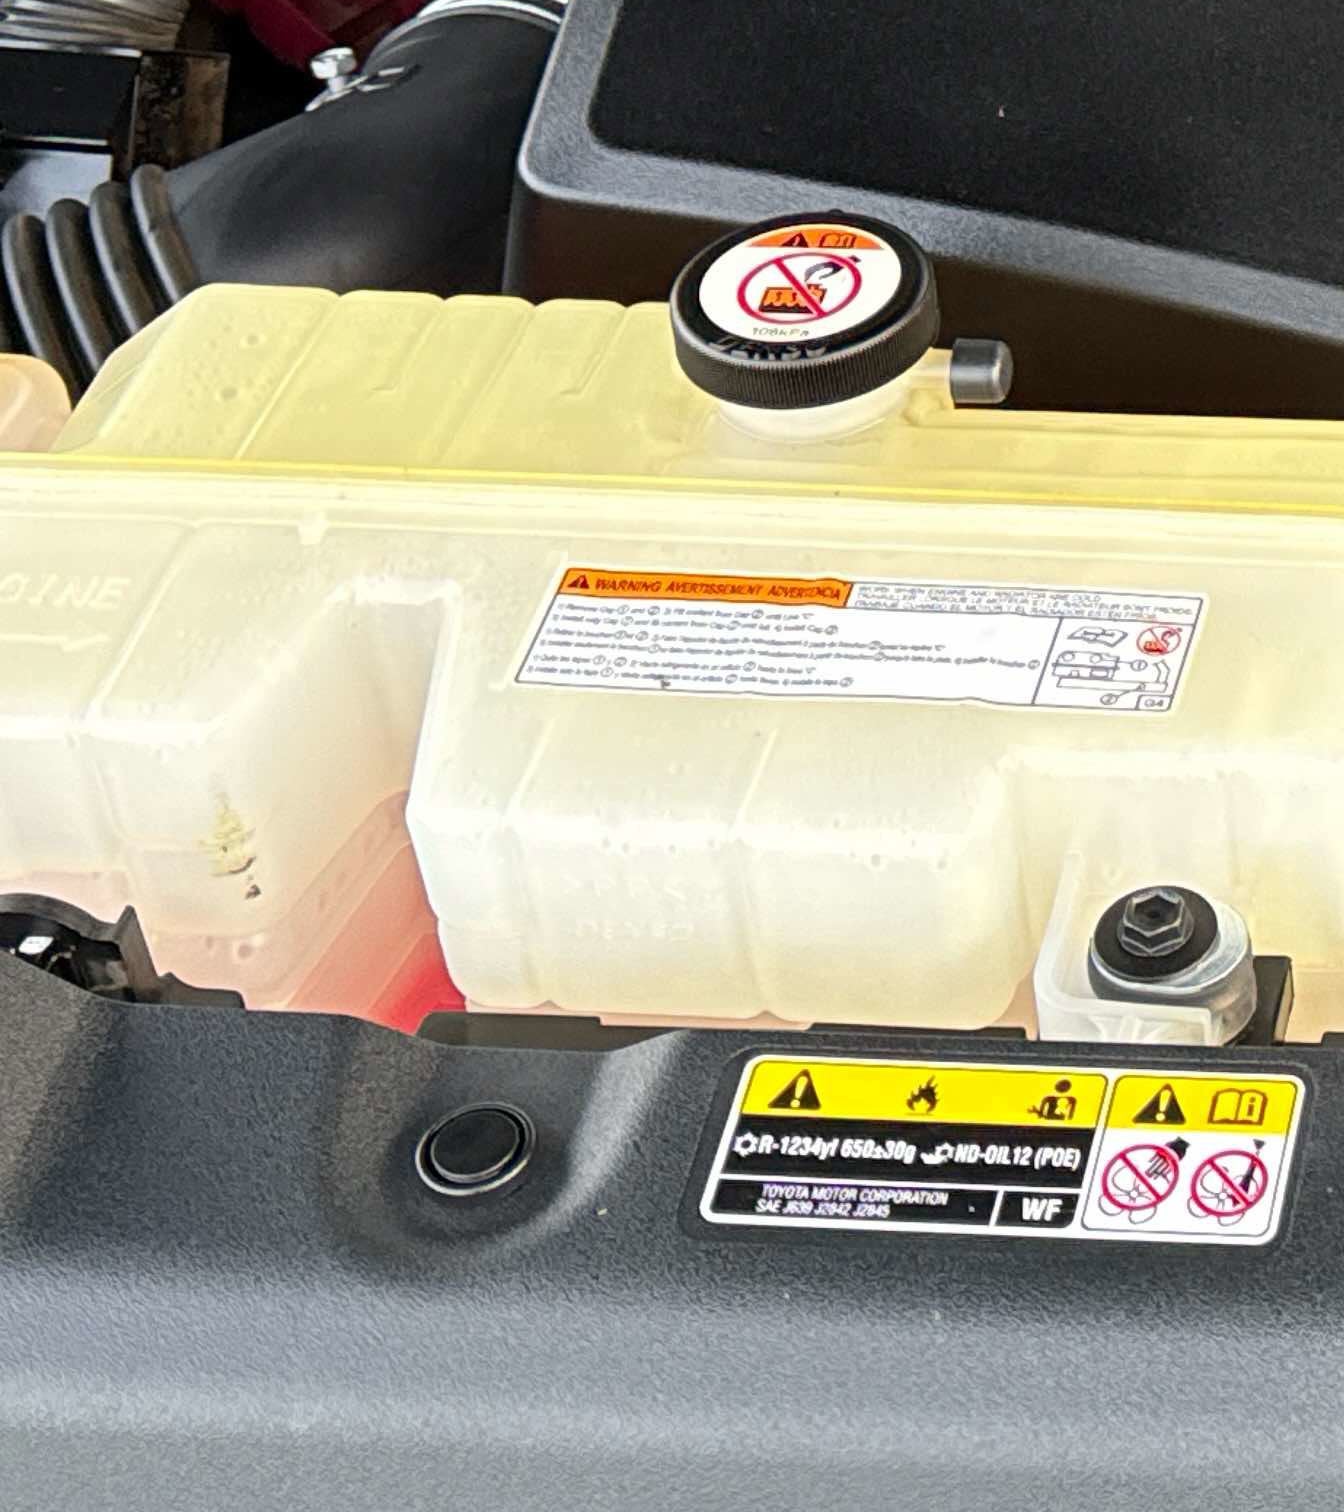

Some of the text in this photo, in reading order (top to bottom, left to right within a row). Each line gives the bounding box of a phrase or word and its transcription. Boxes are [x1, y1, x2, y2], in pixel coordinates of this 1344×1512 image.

[594, 578, 662, 593] WARNING
[1034, 1147, 1081, 1172] (POE)
[762, 1183, 949, 1206] TOYOTA MOTOR CORPORATION
[755, 1199, 782, 1214] SAE
[1021, 1197, 1063, 1221] WF
